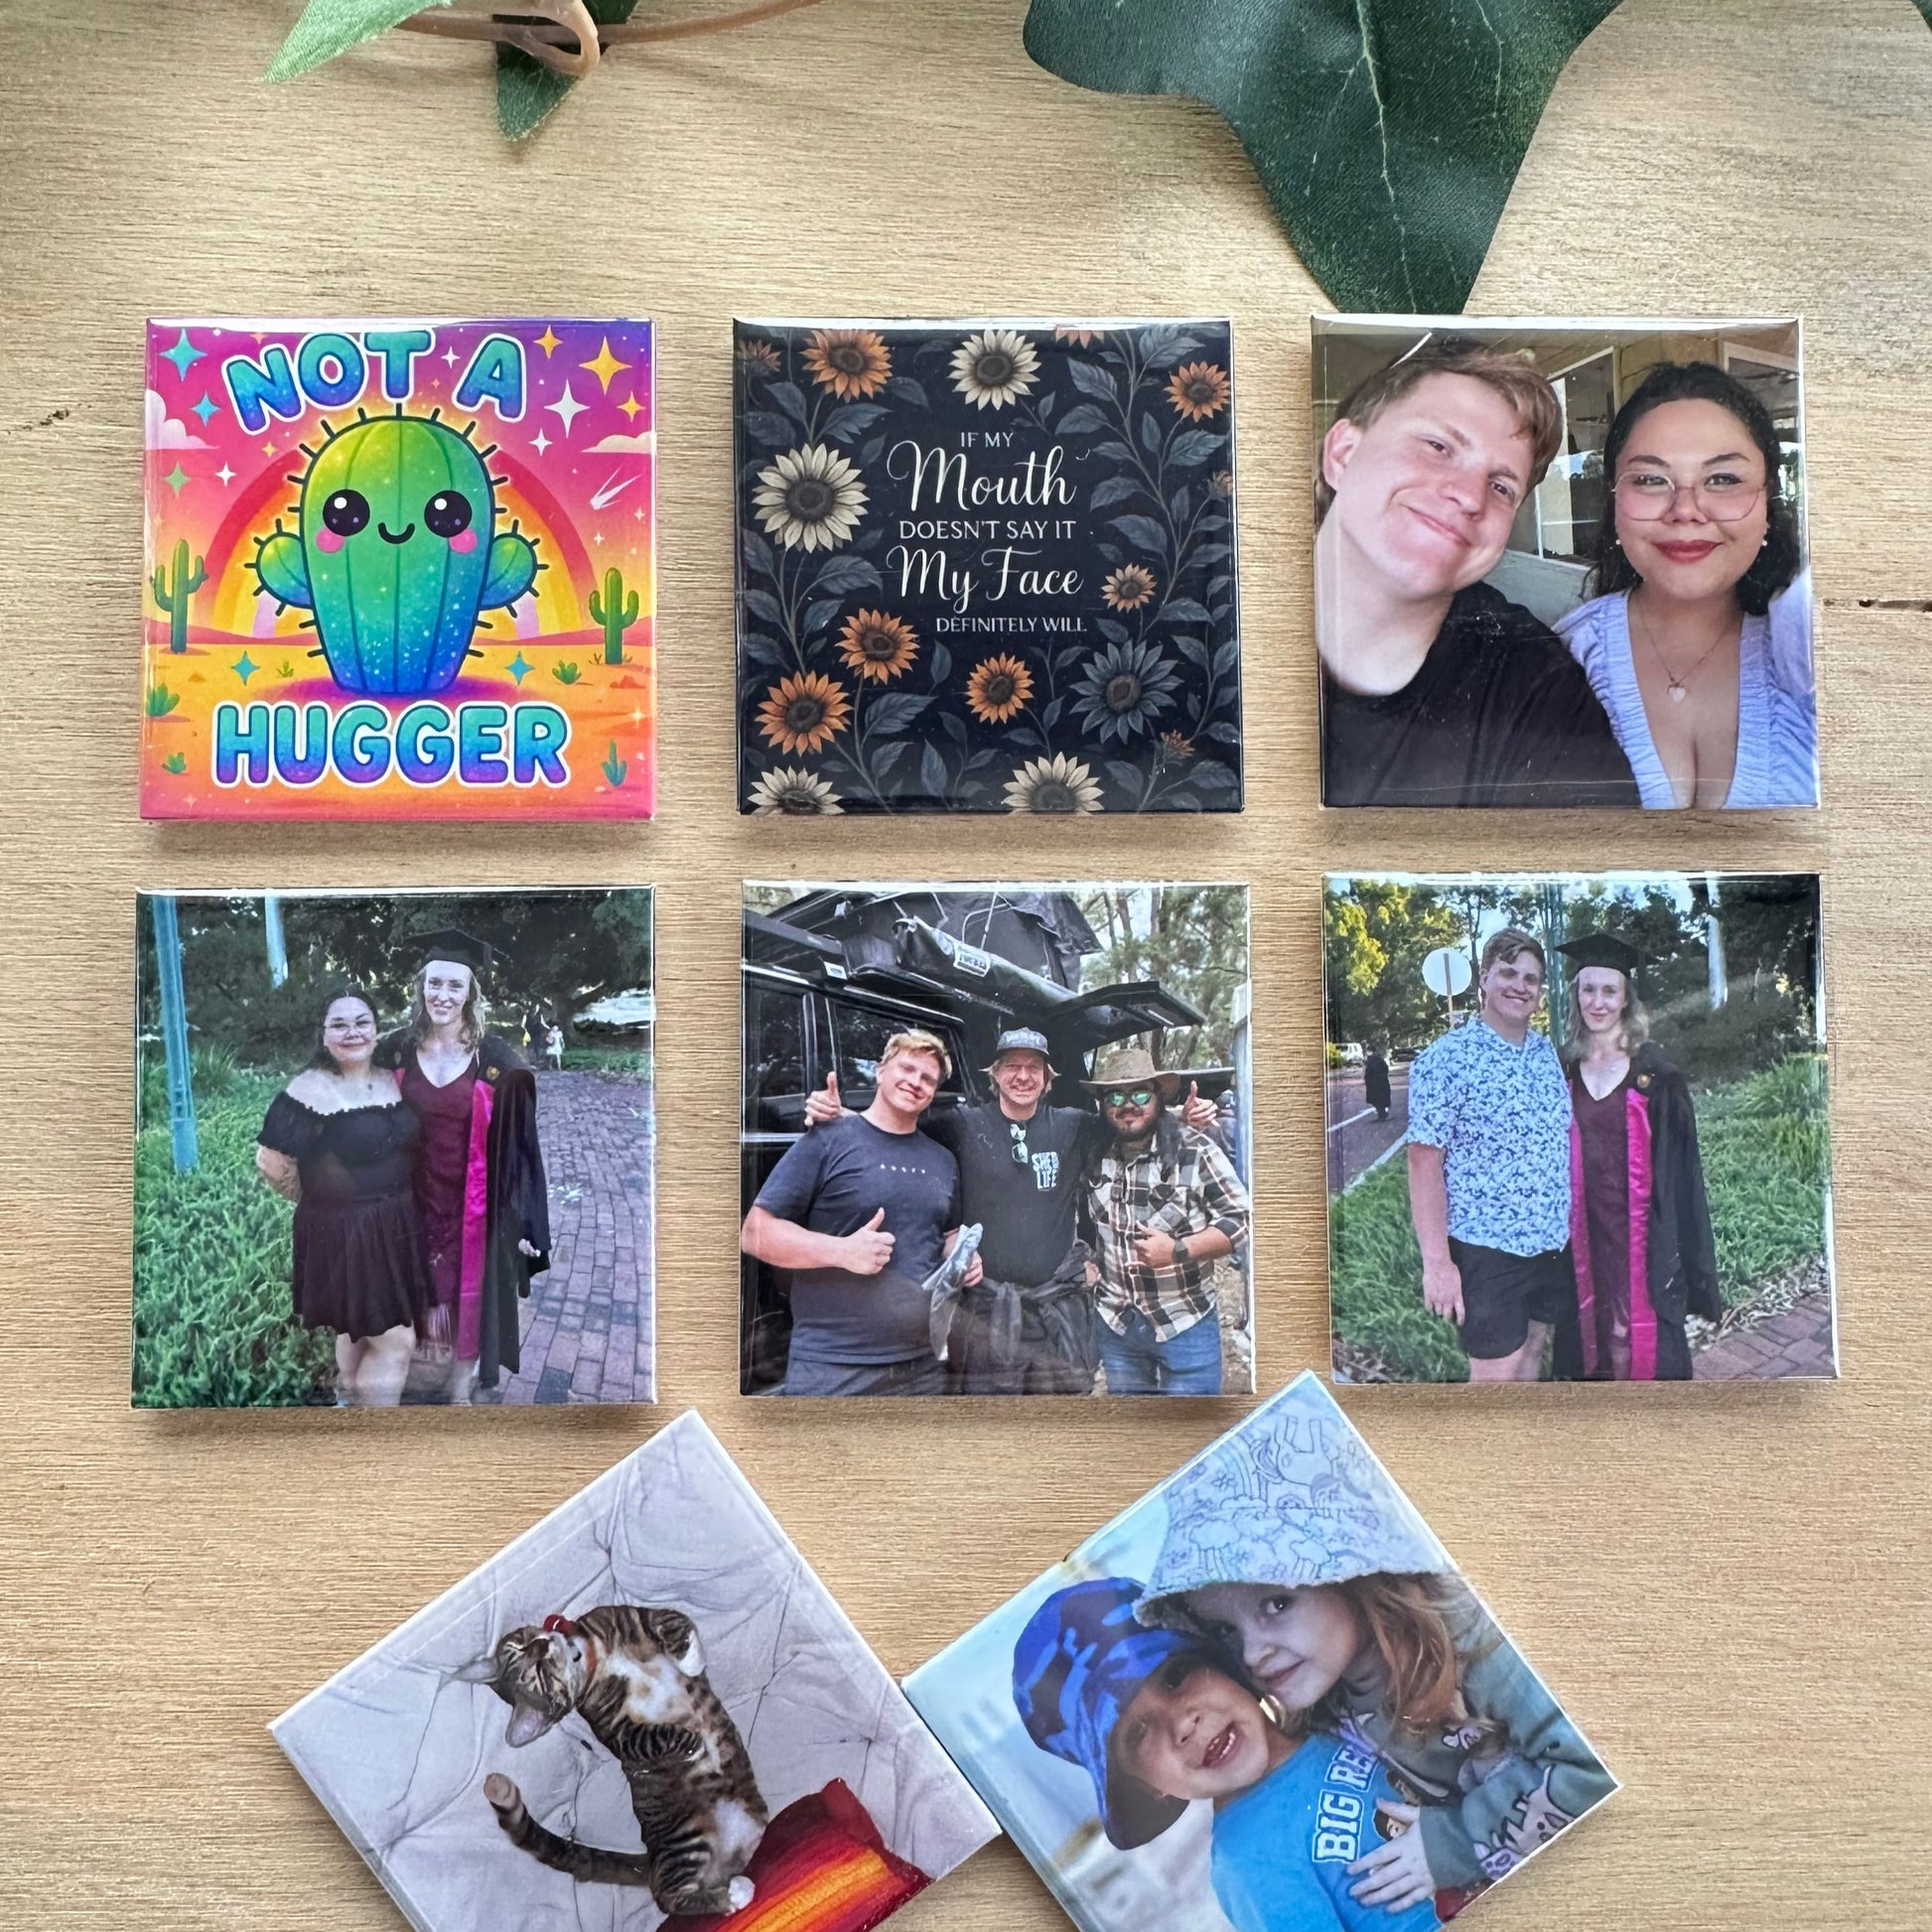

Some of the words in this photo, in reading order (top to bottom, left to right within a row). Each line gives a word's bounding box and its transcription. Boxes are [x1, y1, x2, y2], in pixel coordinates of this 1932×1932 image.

[223, 329, 434, 434] NOT
[453, 332, 527, 422] A
[960, 432, 979, 448] IF
[985, 432, 1015, 448] MY
[887, 440, 1077, 511] Mouth
[899, 520, 1001, 540] DOESN'T
[1007, 520, 1048, 540] SAY
[1055, 520, 1077, 540] IT
[887, 545, 979, 615] My
[981, 546, 1084, 601] Face
[936, 617, 1037, 632] DEFINITELY
[1041, 617, 1087, 632] WILL
[211, 701, 571, 787] HUGGER
[1324, 1744, 1378, 1792] RE
[1314, 1790, 1363, 1863] BIG
